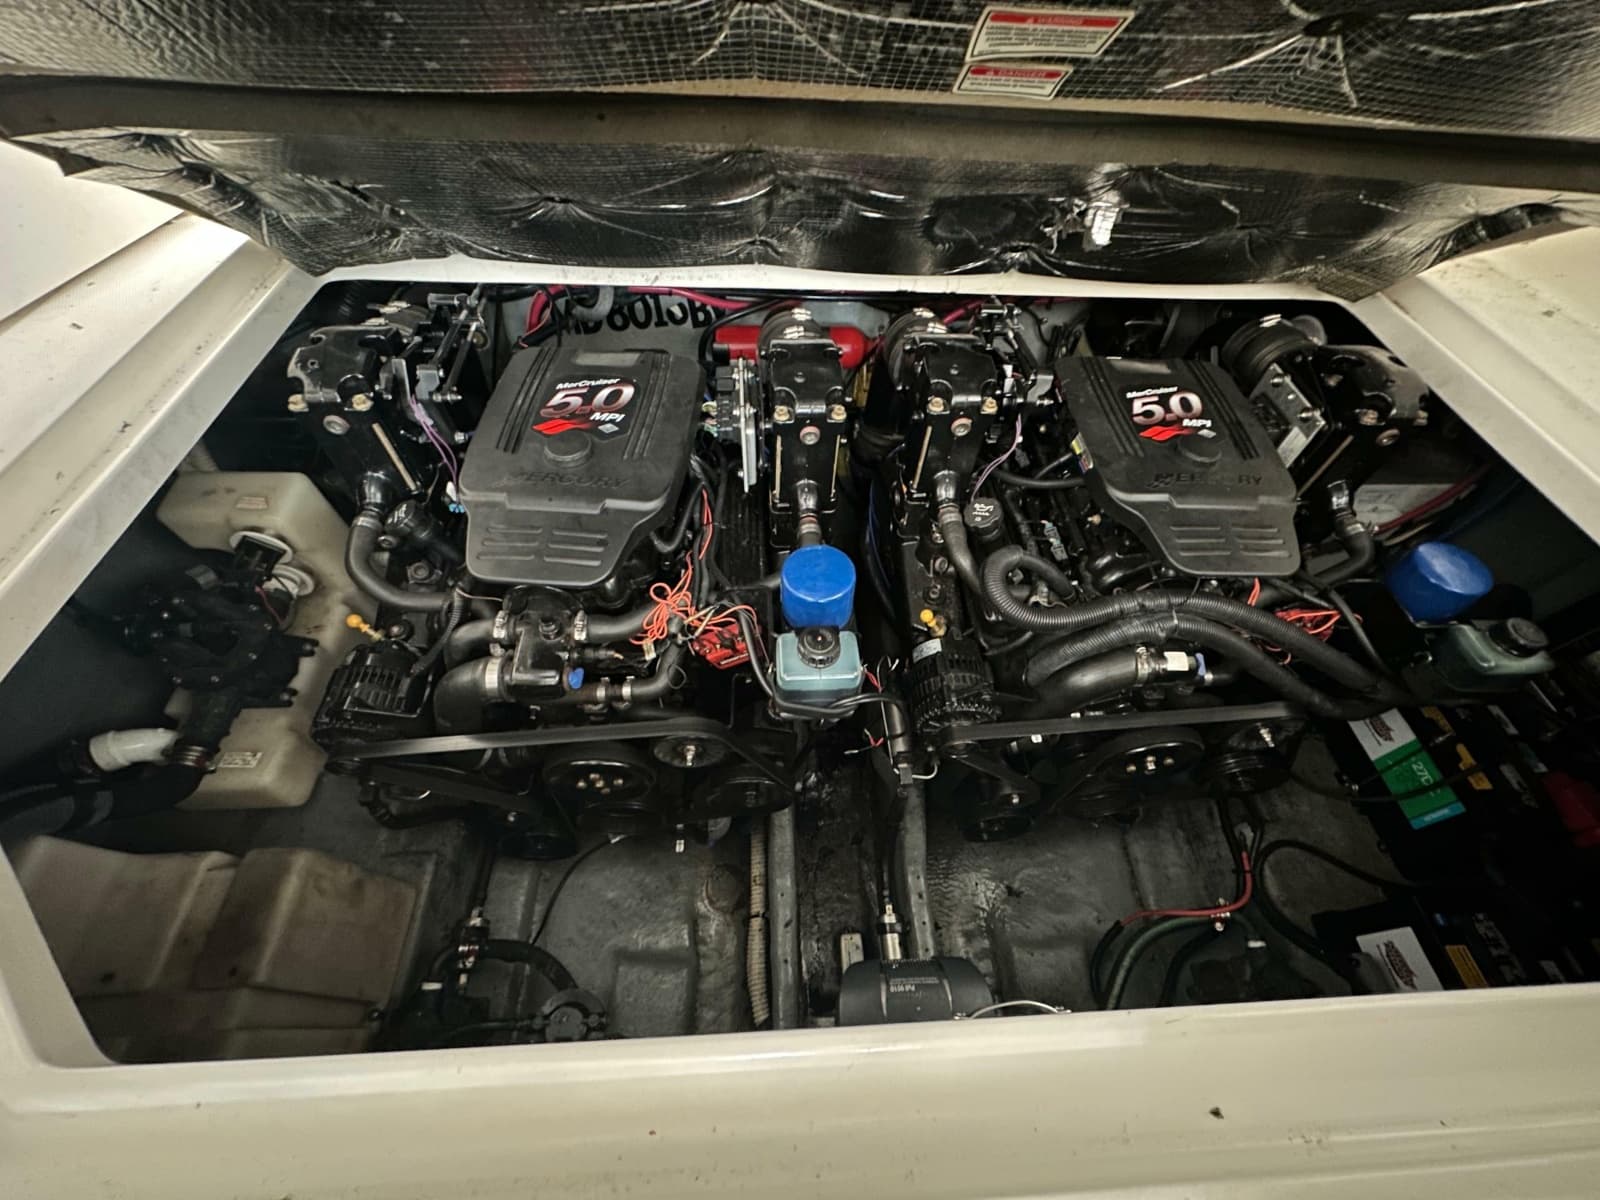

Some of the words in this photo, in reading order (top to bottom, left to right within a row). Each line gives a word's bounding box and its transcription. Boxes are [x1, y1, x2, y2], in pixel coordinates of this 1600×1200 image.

[555, 378, 621, 390] MerCruiser
[1125, 386, 1179, 399] MerCruiser
[541, 383, 635, 418] 5.0
[1132, 391, 1202, 426] 5.0
[589, 412, 626, 423] MPI
[1182, 418, 1212, 428] MPI
